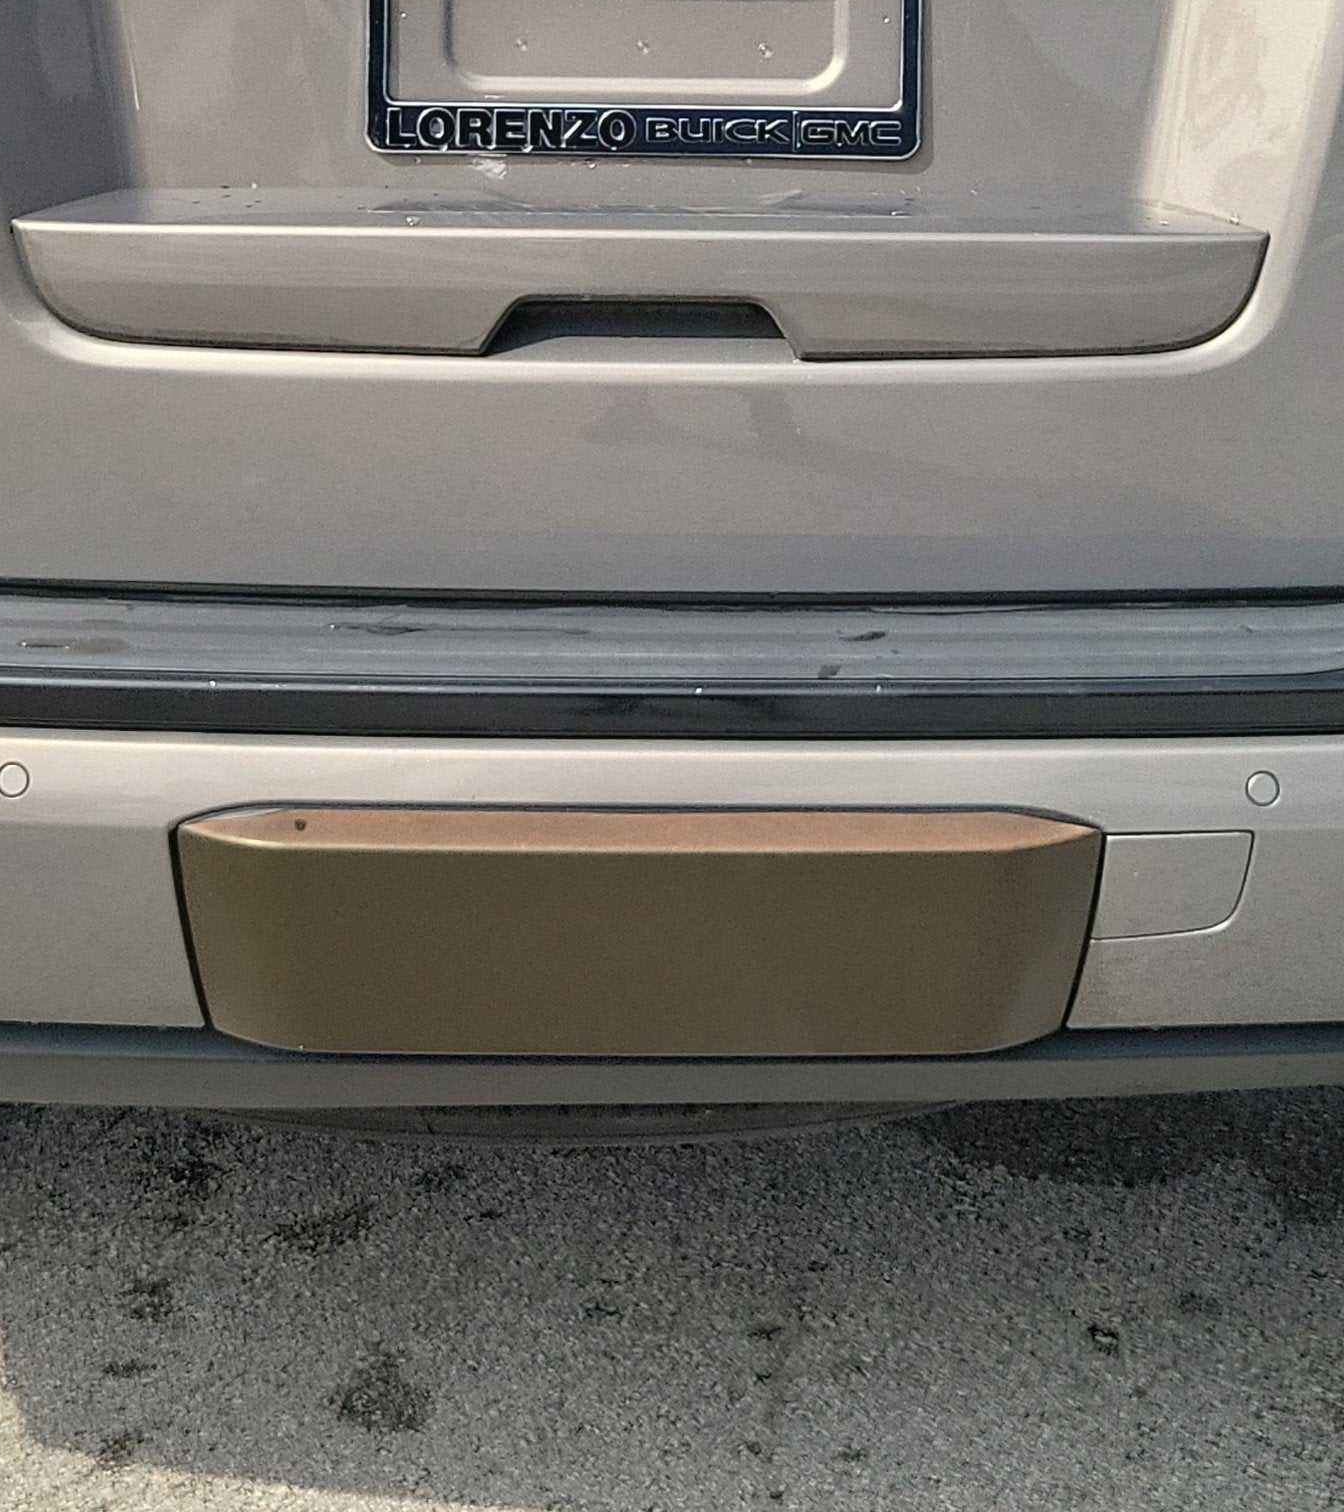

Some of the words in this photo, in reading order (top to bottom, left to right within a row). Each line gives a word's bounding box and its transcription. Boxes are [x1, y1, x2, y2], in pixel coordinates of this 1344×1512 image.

[386, 108, 635, 150] LORENZO
[645, 117, 789, 145] BUICK
[800, 120, 902, 148] GMC
